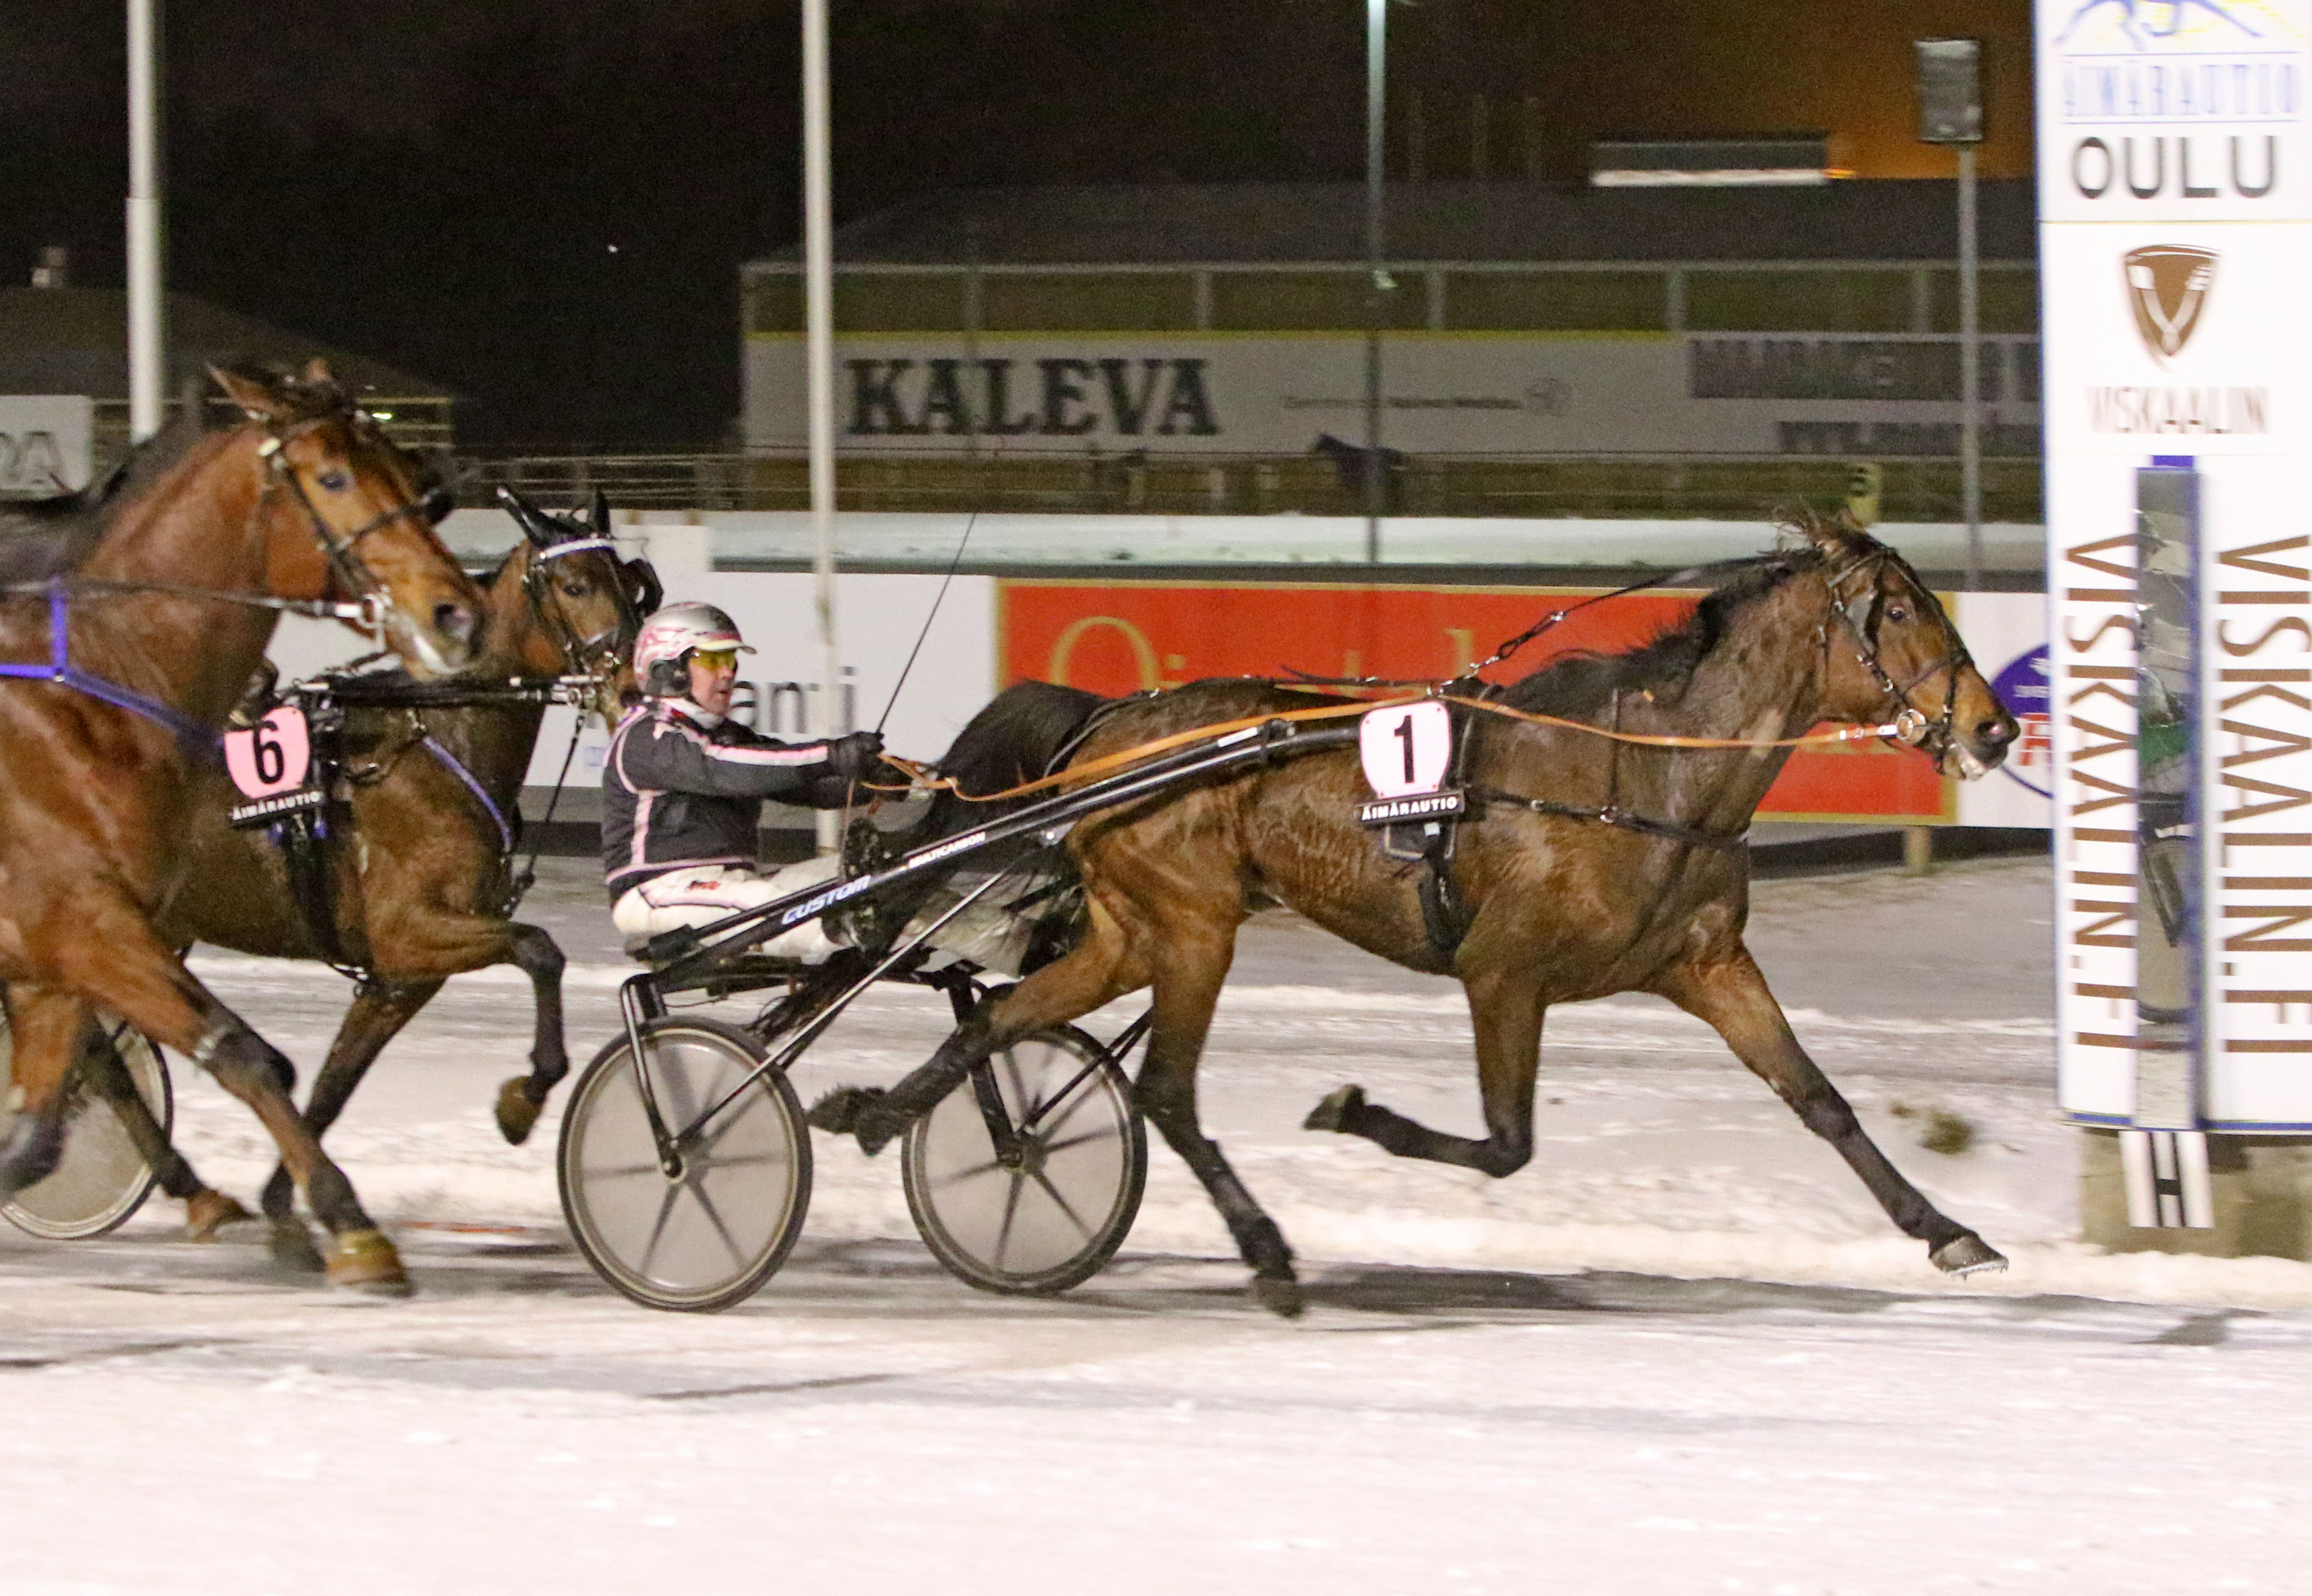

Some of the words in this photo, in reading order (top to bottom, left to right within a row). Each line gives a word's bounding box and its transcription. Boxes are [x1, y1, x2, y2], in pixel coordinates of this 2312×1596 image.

[2072, 135, 2277, 199] OULU
[844, 357, 1221, 436] KALEVA
[2084, 385, 2270, 434] VISKAALIN
[253, 720, 284, 784] 6
[1394, 714, 1414, 784] 1
[2215, 534, 2312, 1054] VISKAALIN.FI
